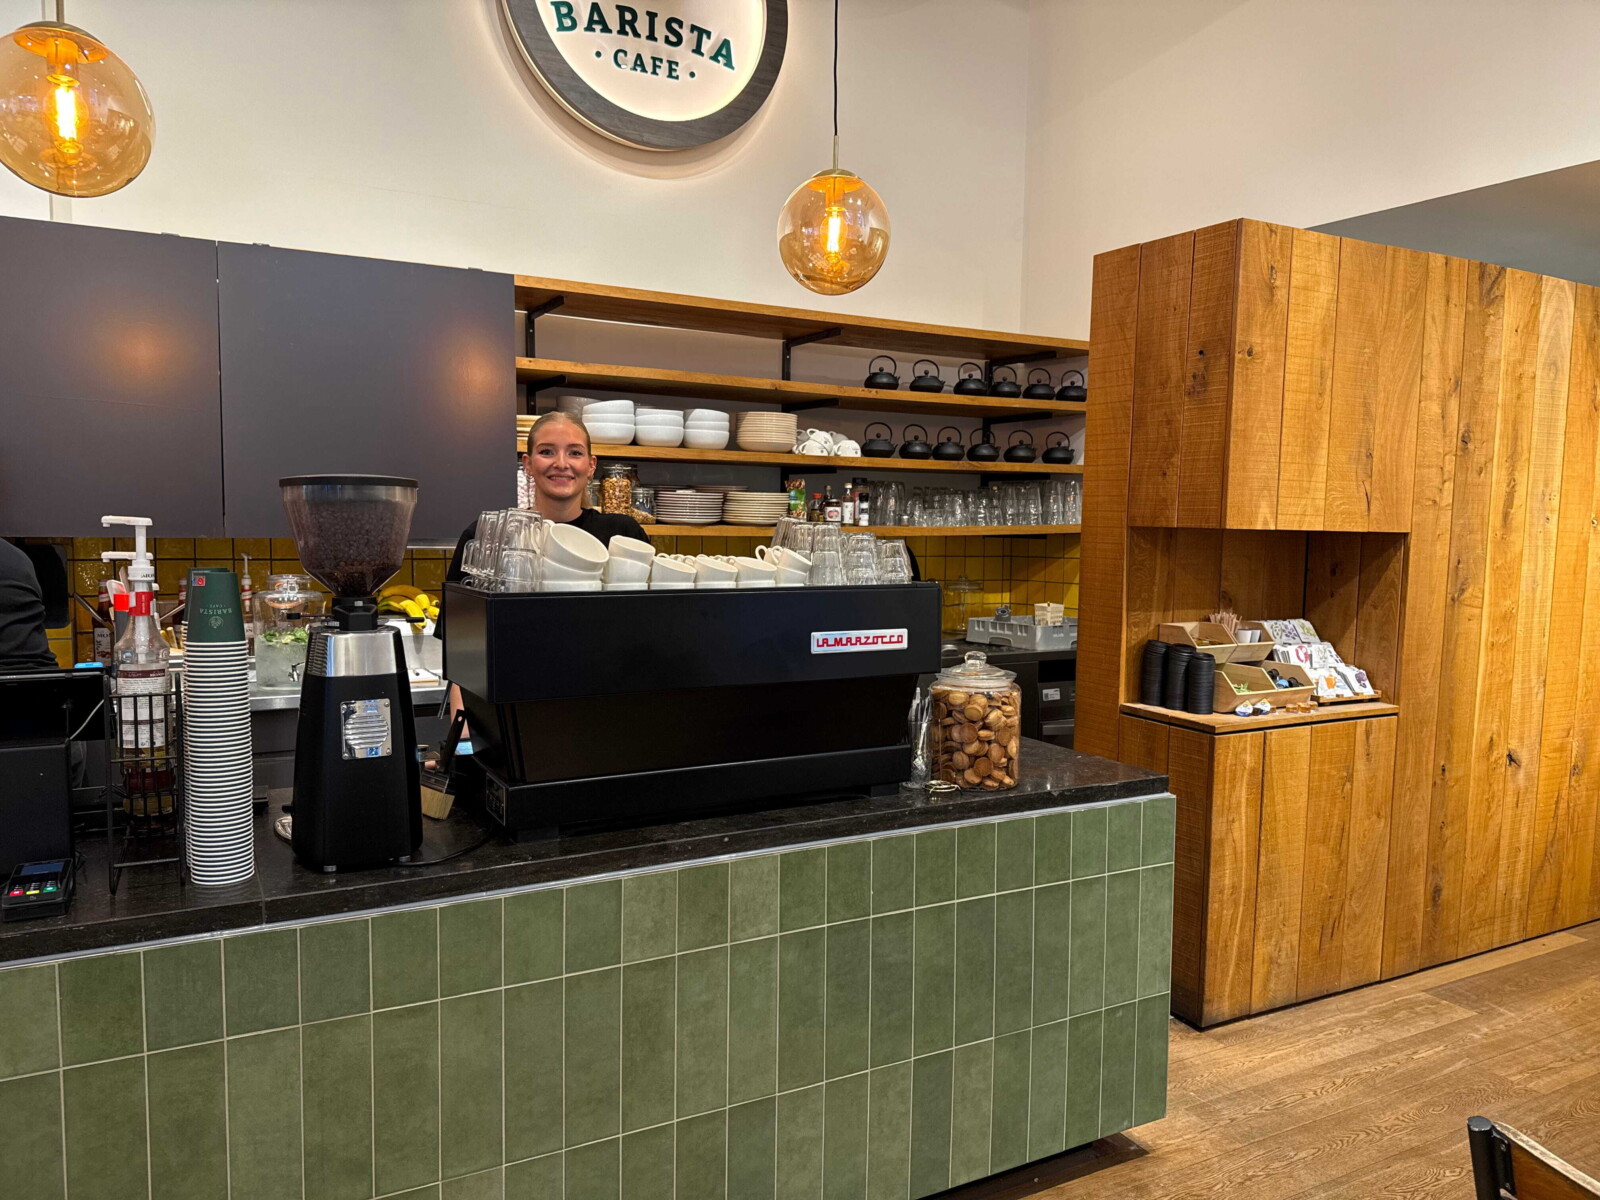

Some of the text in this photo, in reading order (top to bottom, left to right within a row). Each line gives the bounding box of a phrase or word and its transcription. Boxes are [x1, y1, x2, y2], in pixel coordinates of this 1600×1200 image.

[551, 0, 735, 71] BARISTA
[613, 48, 679, 80] CAFE
[200, 607, 232, 615] BARISTA
[817, 637, 829, 648] LA
